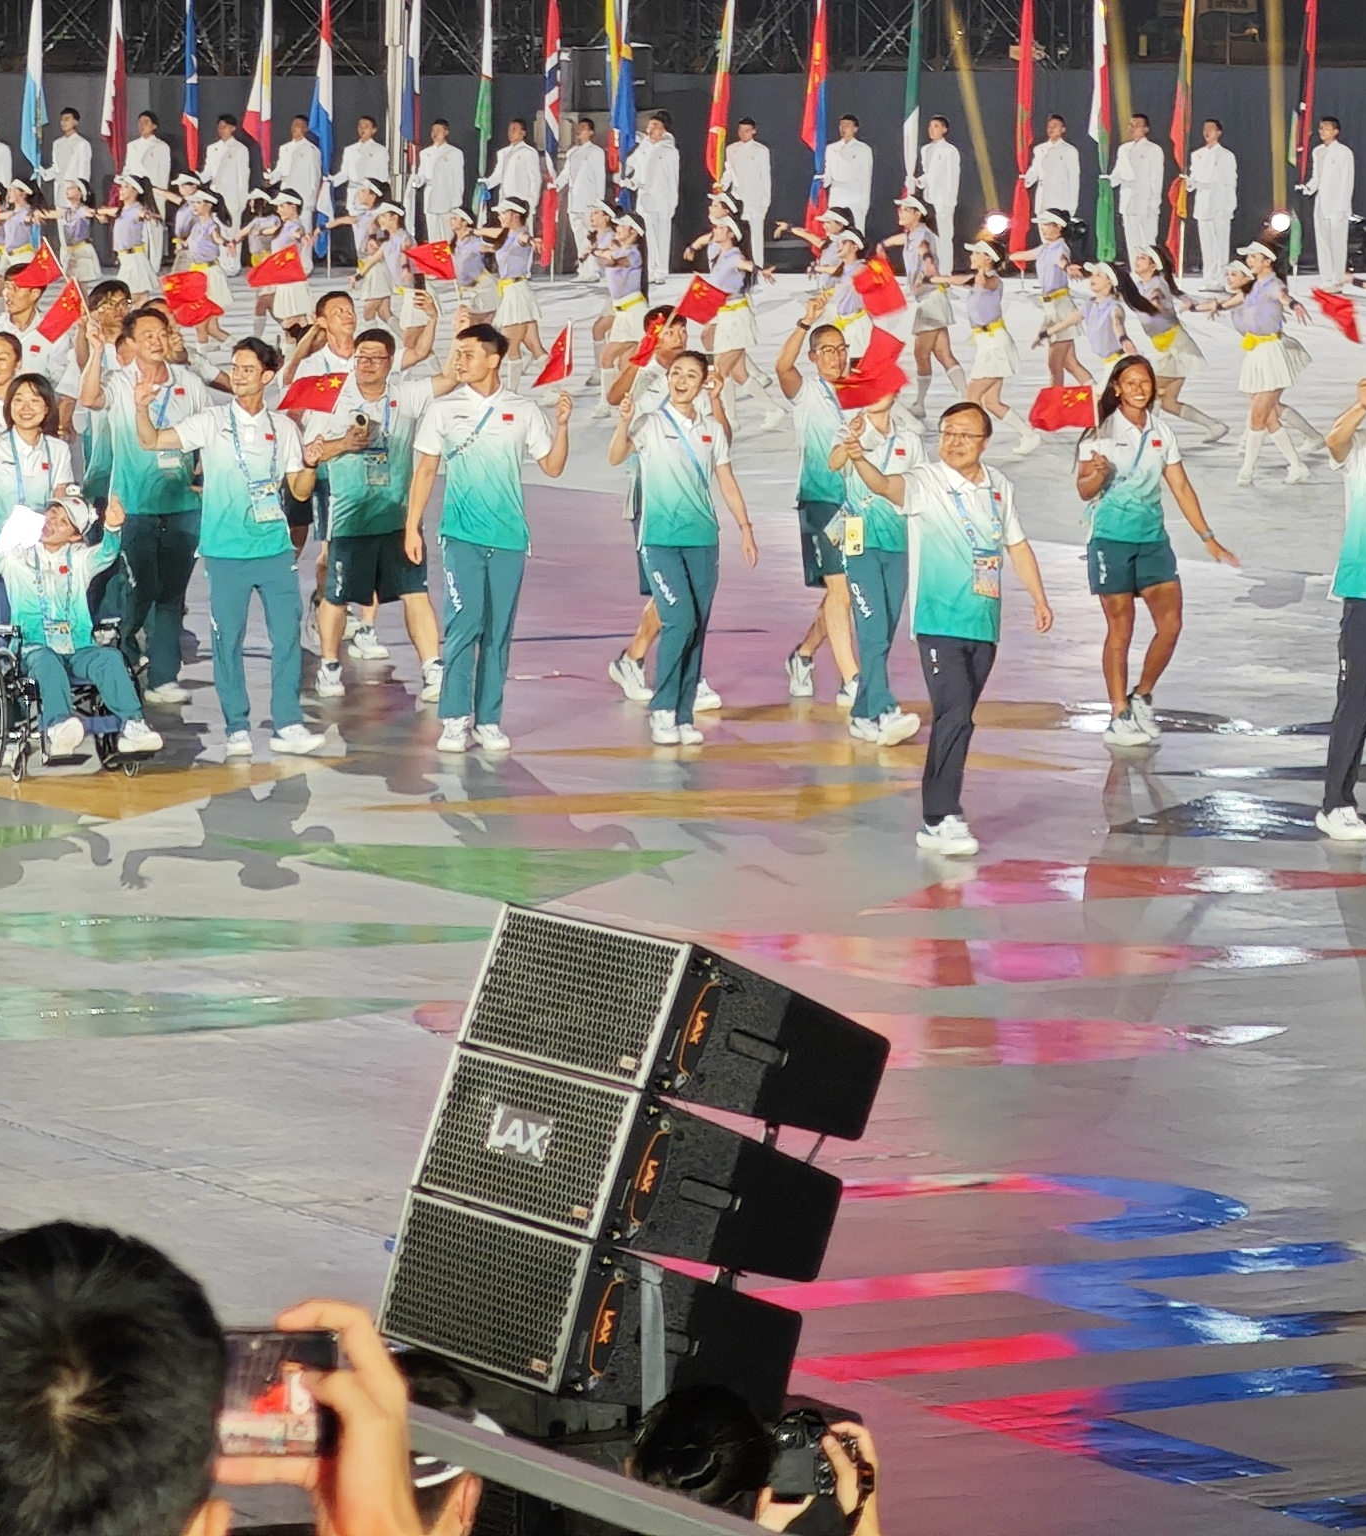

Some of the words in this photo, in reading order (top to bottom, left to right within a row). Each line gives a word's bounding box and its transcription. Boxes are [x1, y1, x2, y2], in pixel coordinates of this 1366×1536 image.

[690, 1011, 709, 1043] LAX
[488, 1103, 550, 1161] LAX
[640, 1160, 659, 1192] LAX
[598, 1309, 617, 1343] LAX
